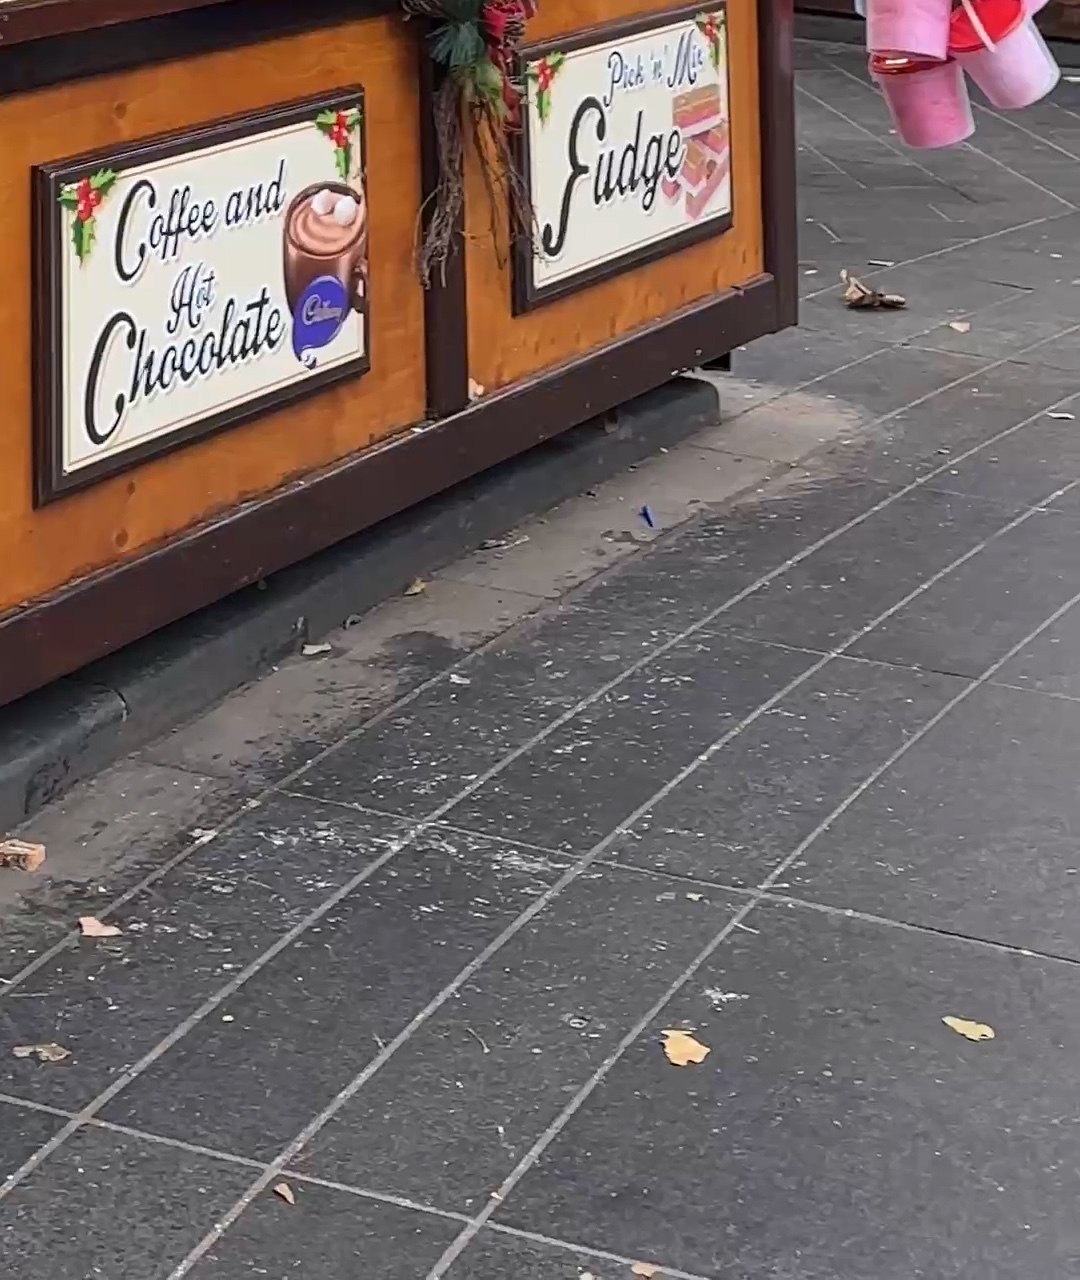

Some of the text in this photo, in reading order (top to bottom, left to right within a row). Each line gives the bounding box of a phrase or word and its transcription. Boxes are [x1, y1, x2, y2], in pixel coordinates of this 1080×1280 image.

[603, 50, 644, 108] Pick
[114, 159, 286, 282] Coffee and
[541, 95, 684, 257] Fudge
[167, 262, 215, 335] Hot
[83, 286, 284, 445] Chocolate
